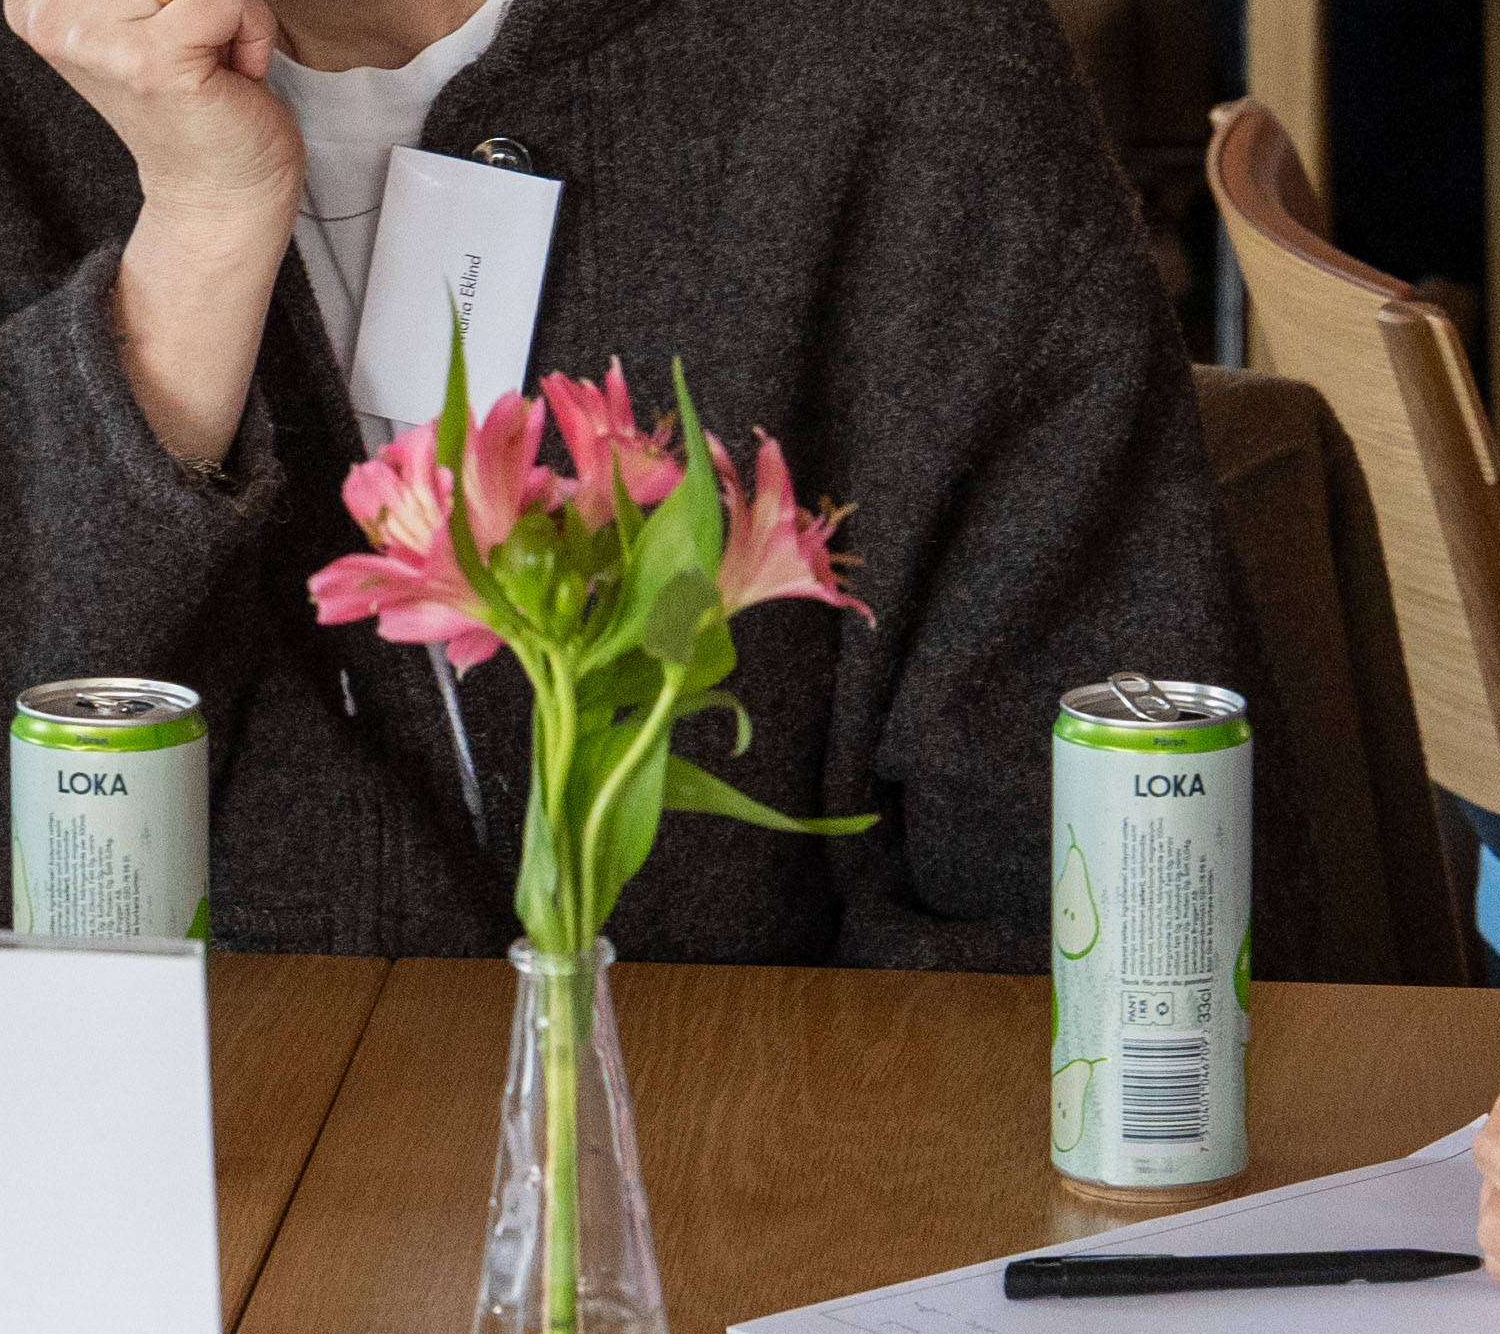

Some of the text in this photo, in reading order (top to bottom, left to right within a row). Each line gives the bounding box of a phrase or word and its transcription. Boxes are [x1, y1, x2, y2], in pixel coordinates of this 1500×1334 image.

[459, 253, 481, 298] Eklind
[57, 770, 128, 796] LOKA
[1135, 773, 1206, 798] LOKA
[1127, 994, 1137, 1022] PANT
[1197, 988, 1212, 1024] 33cl
